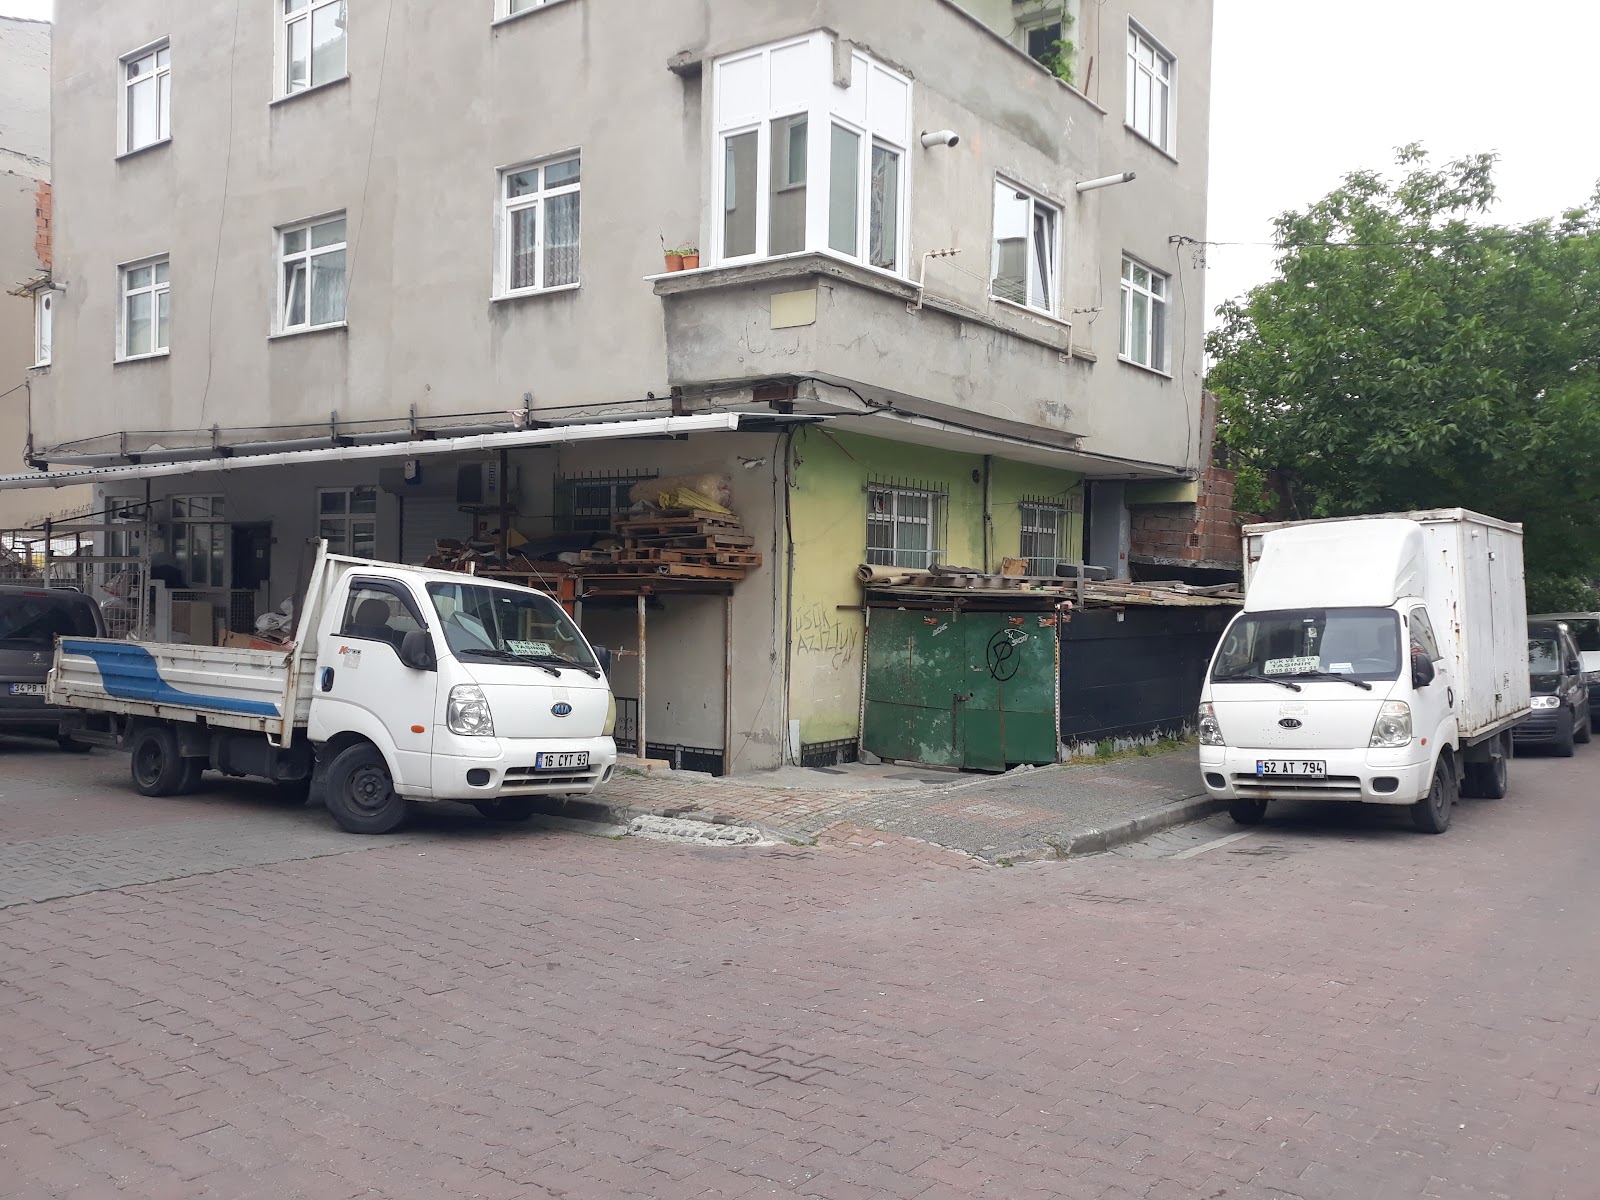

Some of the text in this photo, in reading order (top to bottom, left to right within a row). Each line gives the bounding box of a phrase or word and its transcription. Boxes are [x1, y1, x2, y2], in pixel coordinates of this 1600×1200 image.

[14, 684, 25, 692] 34
[27, 684, 37, 692] PB
[554, 704, 569, 713] KIA
[1282, 719, 1298, 727] KIA
[544, 753, 587, 767] 16 CYT 93
[1264, 762, 1323, 774] 52 AT 794
